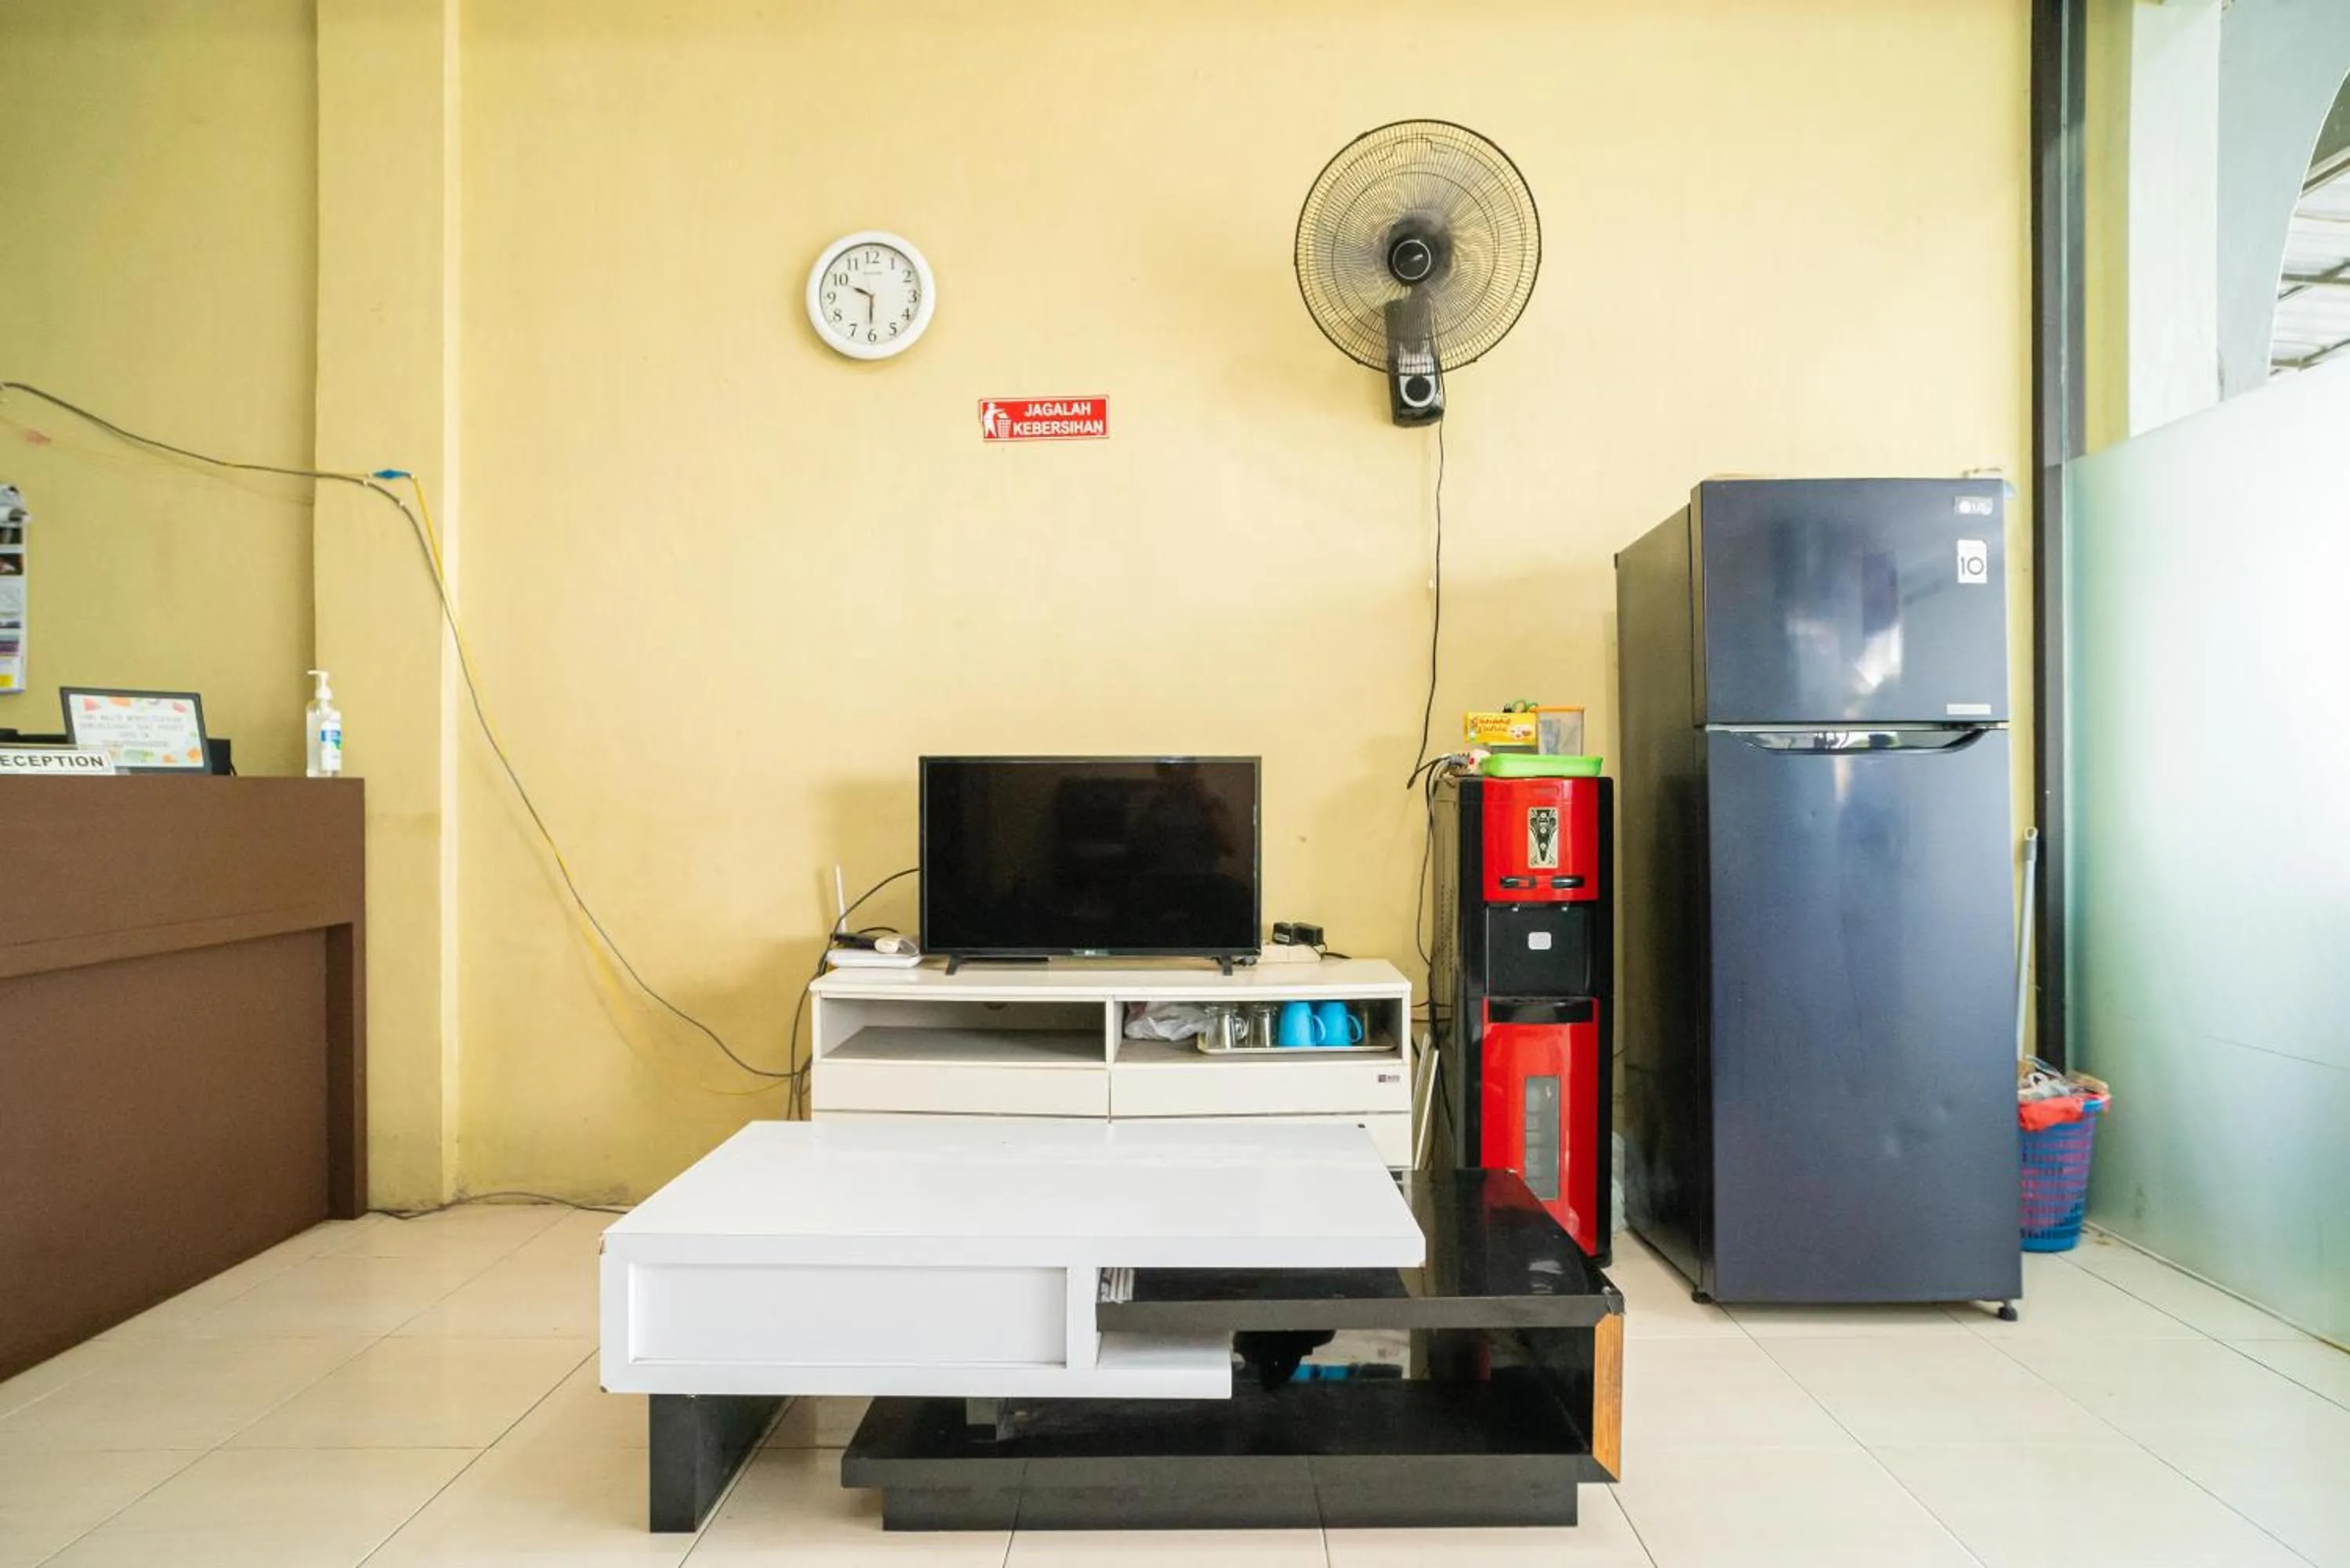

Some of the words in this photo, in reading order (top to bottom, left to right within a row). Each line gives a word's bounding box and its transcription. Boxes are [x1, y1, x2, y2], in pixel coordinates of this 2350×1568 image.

[865, 251, 880, 264] 12
[890, 258, 895, 270] 1
[847, 258, 859, 271] 11
[833, 273, 848, 286] 10
[902, 270, 912, 283] 2
[826, 291, 836, 305] 9
[908, 290, 917, 303] 3
[833, 309, 842, 322] 8
[902, 308, 910, 320] 4
[849, 323, 858, 338] 7
[867, 329, 877, 342] 6
[889, 322, 898, 337] 5
[1024, 402, 1091, 417] JAGALAH
[1013, 420, 1104, 436] KEBERSIHAN
[1961, 556, 1984, 576] 10
[0, 755, 103, 767] ECEPTION
